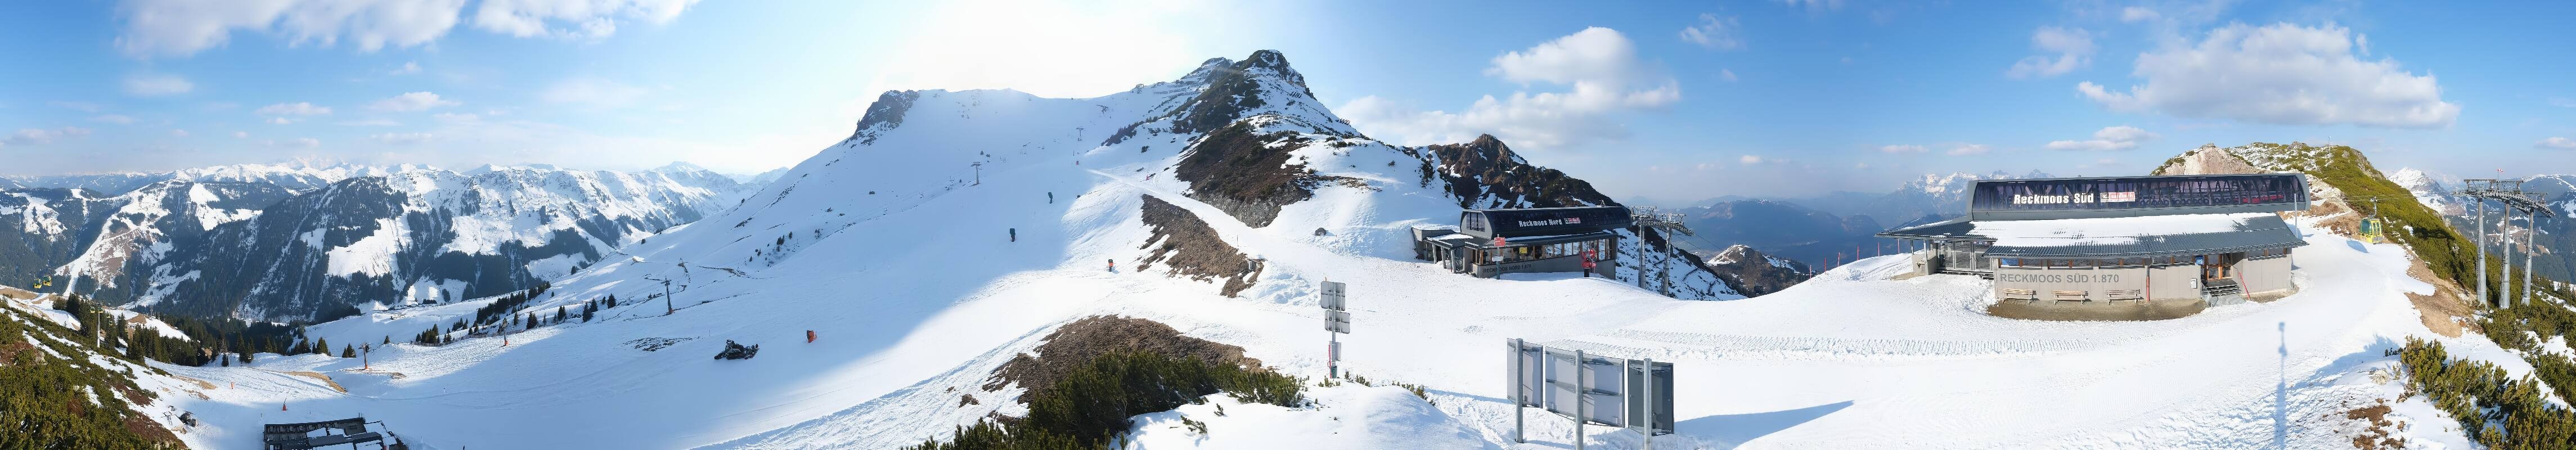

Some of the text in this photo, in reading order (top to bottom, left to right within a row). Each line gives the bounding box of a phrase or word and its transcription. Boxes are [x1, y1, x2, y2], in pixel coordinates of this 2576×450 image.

[2013, 192, 2094, 204] Reckmoos Süd
[2000, 273, 2119, 283] RECKMOOS SÜD 1.870
